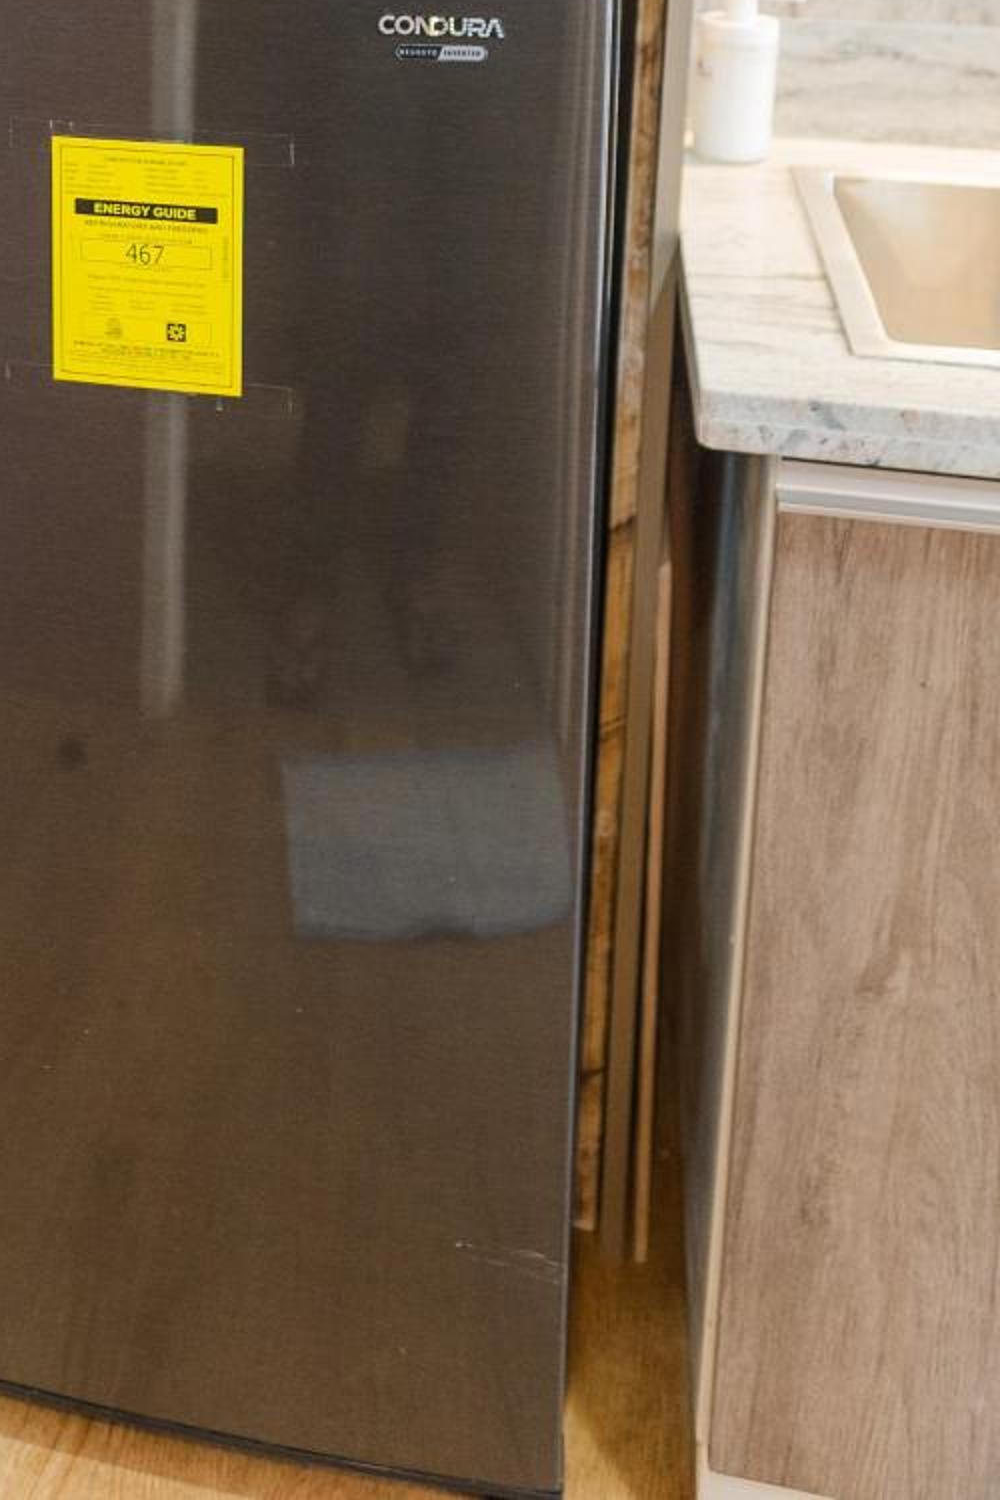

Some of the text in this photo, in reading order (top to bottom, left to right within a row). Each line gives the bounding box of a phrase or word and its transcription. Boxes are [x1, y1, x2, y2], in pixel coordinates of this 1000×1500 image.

[377, 14, 506, 39] CONDURA
[93, 202, 197, 221] ENERGY GUIDE
[125, 243, 165, 266] 467
